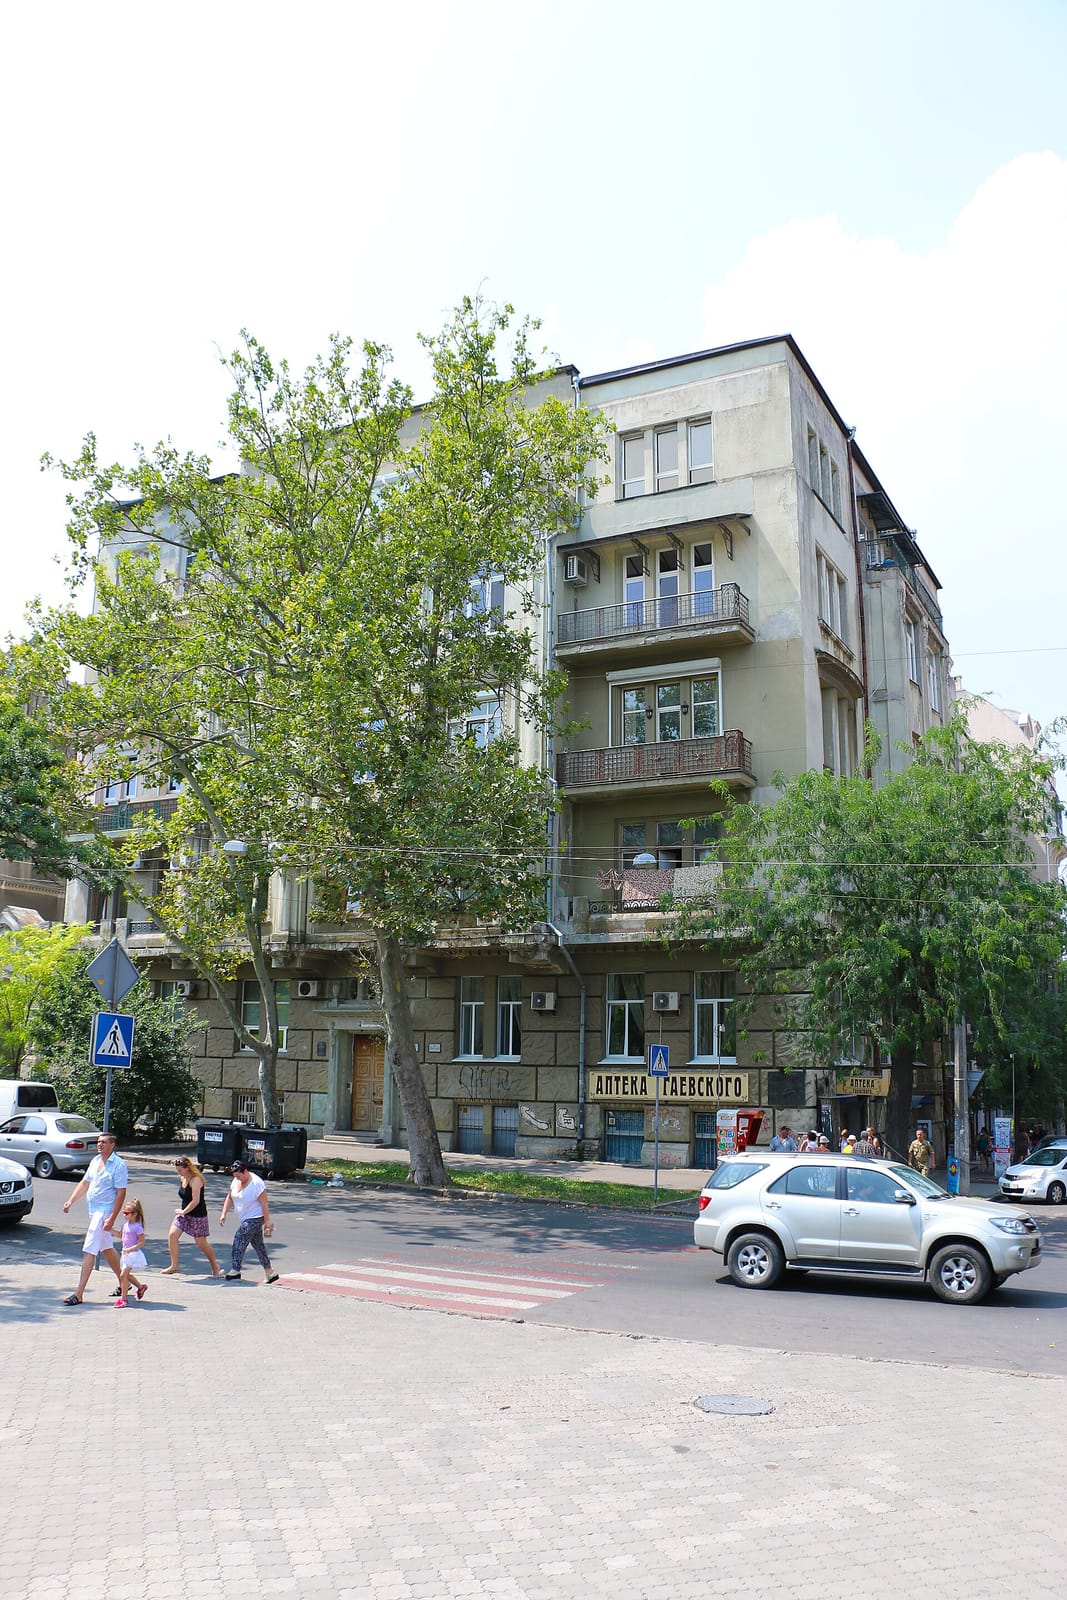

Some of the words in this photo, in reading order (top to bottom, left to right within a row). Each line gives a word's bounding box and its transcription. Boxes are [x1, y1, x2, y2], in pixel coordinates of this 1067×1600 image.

[595, 1075, 648, 1095] АПТЕКА
[663, 1076, 742, 1097] ГАЕВСКОГО
[850, 1079, 875, 1088] АПТЕКА
